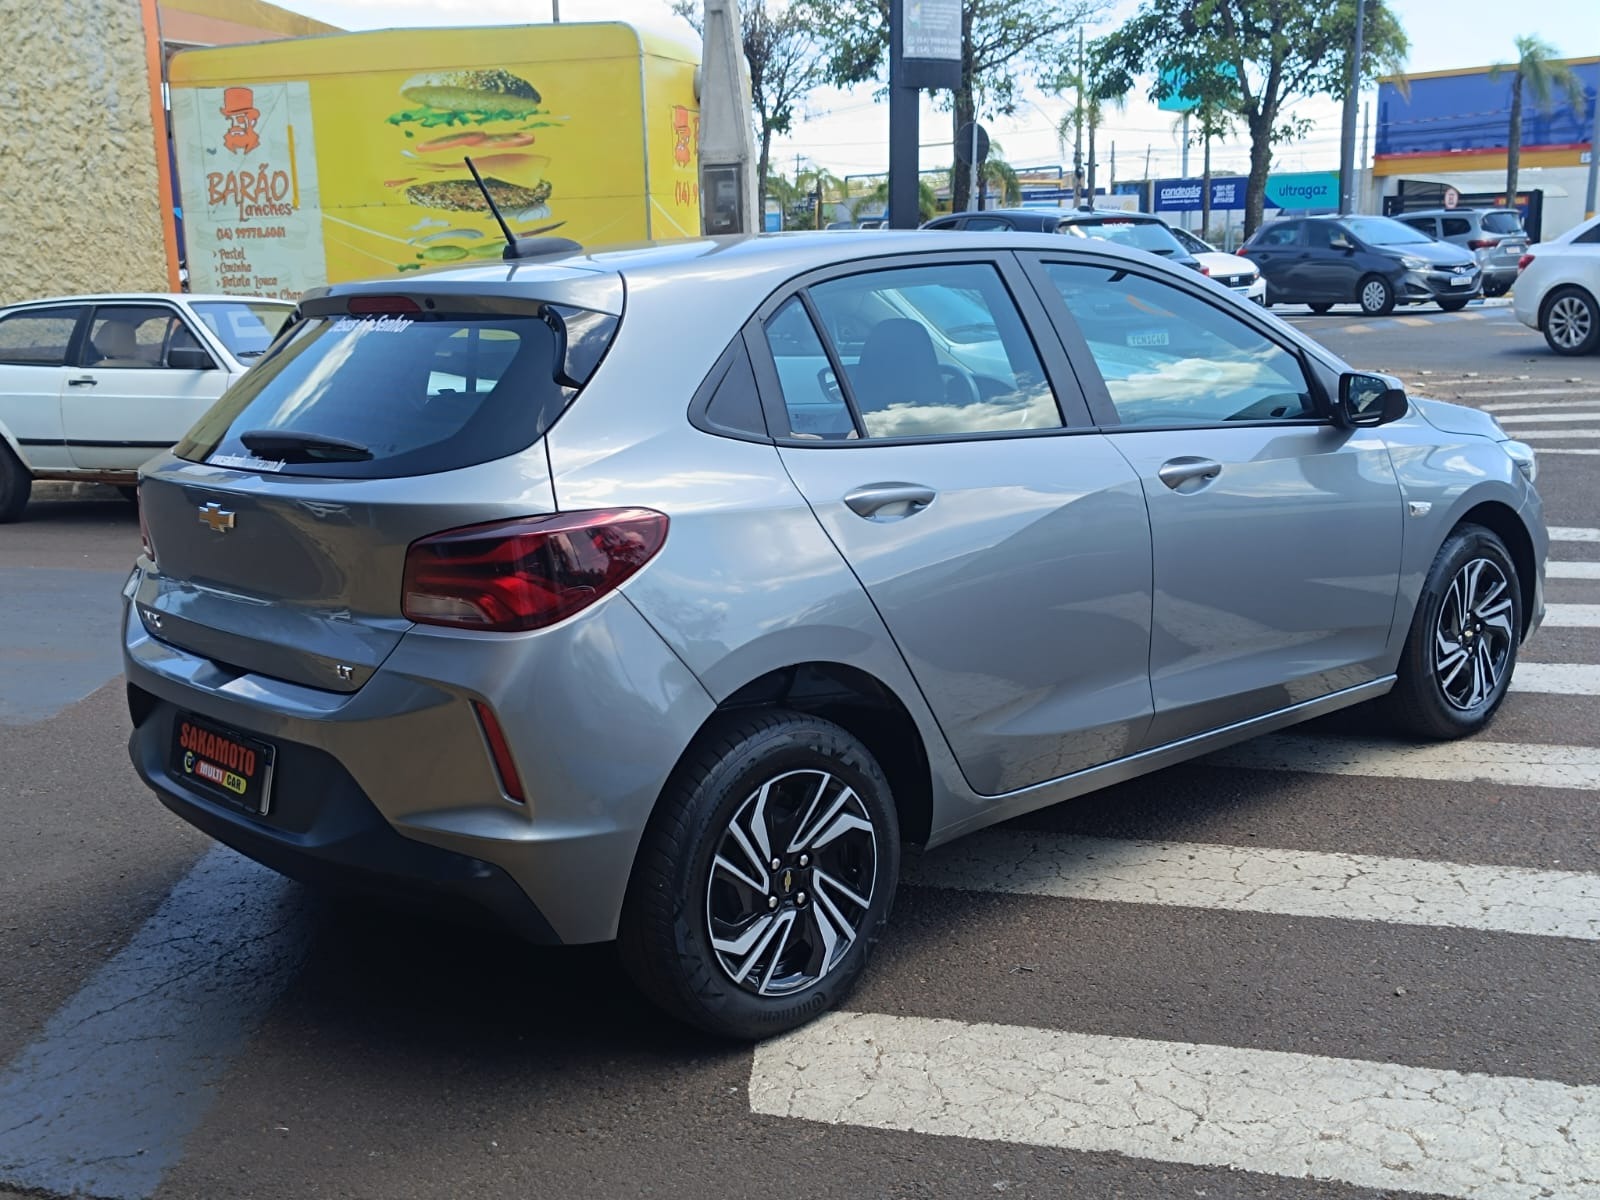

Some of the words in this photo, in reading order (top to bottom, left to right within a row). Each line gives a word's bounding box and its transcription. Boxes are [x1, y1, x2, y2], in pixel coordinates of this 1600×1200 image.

[207, 163, 289, 207] BARÃO
[1279, 184, 1328, 200] ultragaz
[239, 199, 292, 222] Lanches
[218, 246, 246, 261] Pastel
[180, 722, 256, 777] SAKAMOTO
[199, 761, 223, 782] MULTI
[226, 774, 242, 790] CAR
